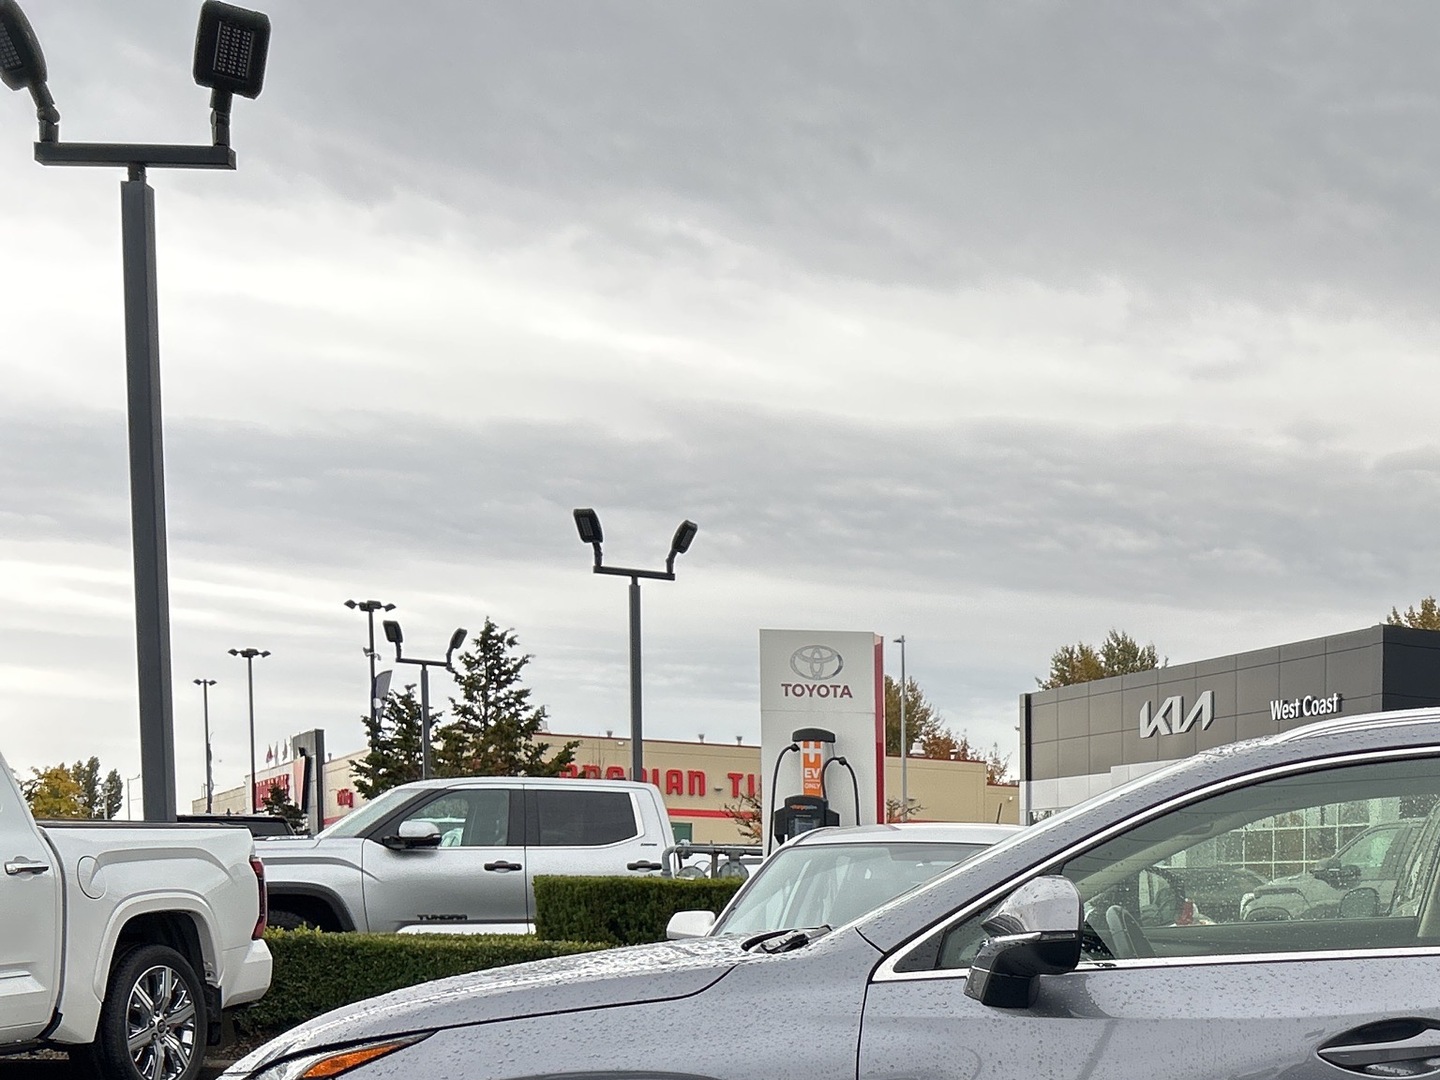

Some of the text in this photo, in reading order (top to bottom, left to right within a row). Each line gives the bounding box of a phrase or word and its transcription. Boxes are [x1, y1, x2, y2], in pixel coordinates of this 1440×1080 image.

[781, 683, 853, 699] TOYOTA
[1139, 690, 1214, 738] KIA
[1270, 692, 1340, 720] West Coast
[804, 768, 820, 778] EV
